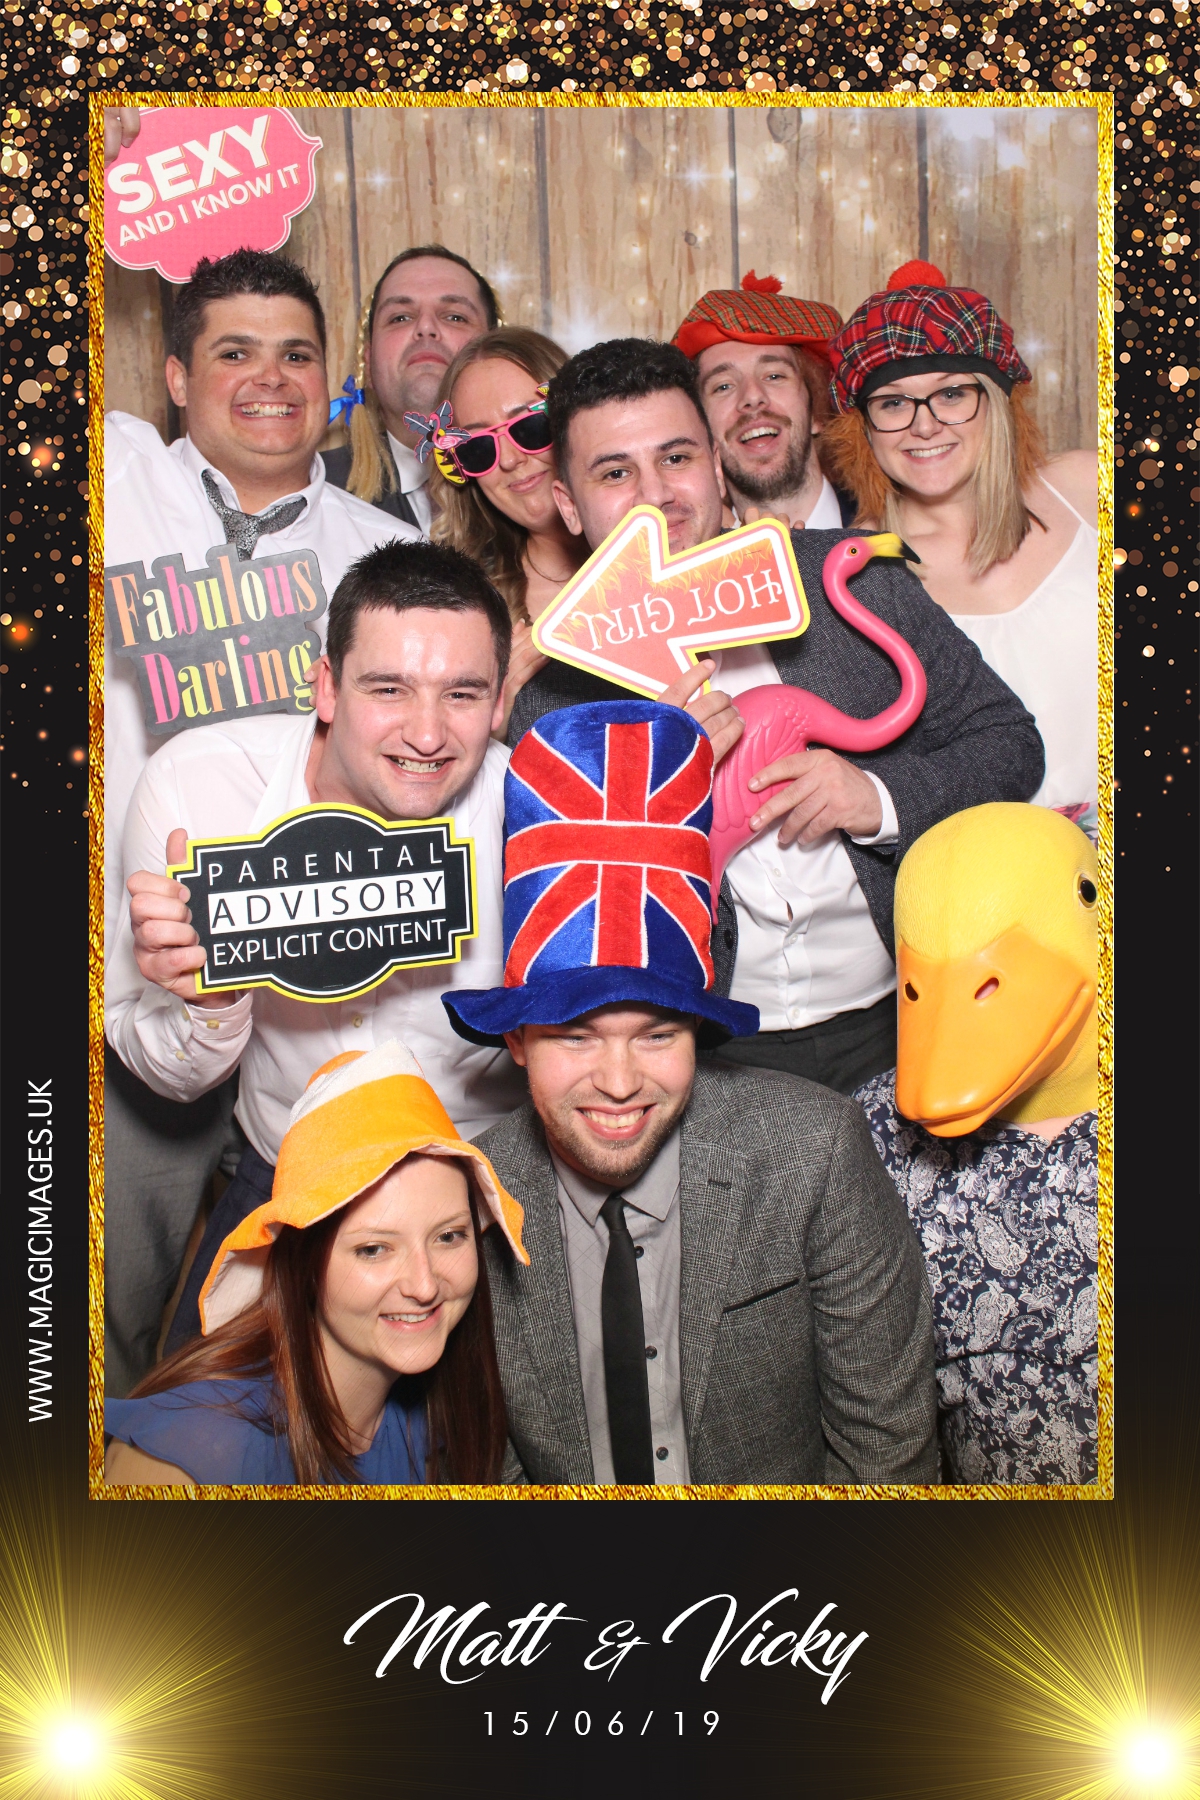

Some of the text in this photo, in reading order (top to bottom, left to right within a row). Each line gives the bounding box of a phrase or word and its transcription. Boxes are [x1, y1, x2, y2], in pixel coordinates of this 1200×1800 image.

[107, 114, 271, 214] SEXY
[119, 163, 300, 247] AND I KNOW IT
[108, 555, 317, 647] Fabulous
[571, 568, 782, 650] HOT GIRL
[141, 634, 317, 725] Darling
[208, 842, 442, 886] PARENTAL
[212, 875, 443, 929] ADVISORY
[213, 918, 446, 966] EXPLICIT CONTENT
